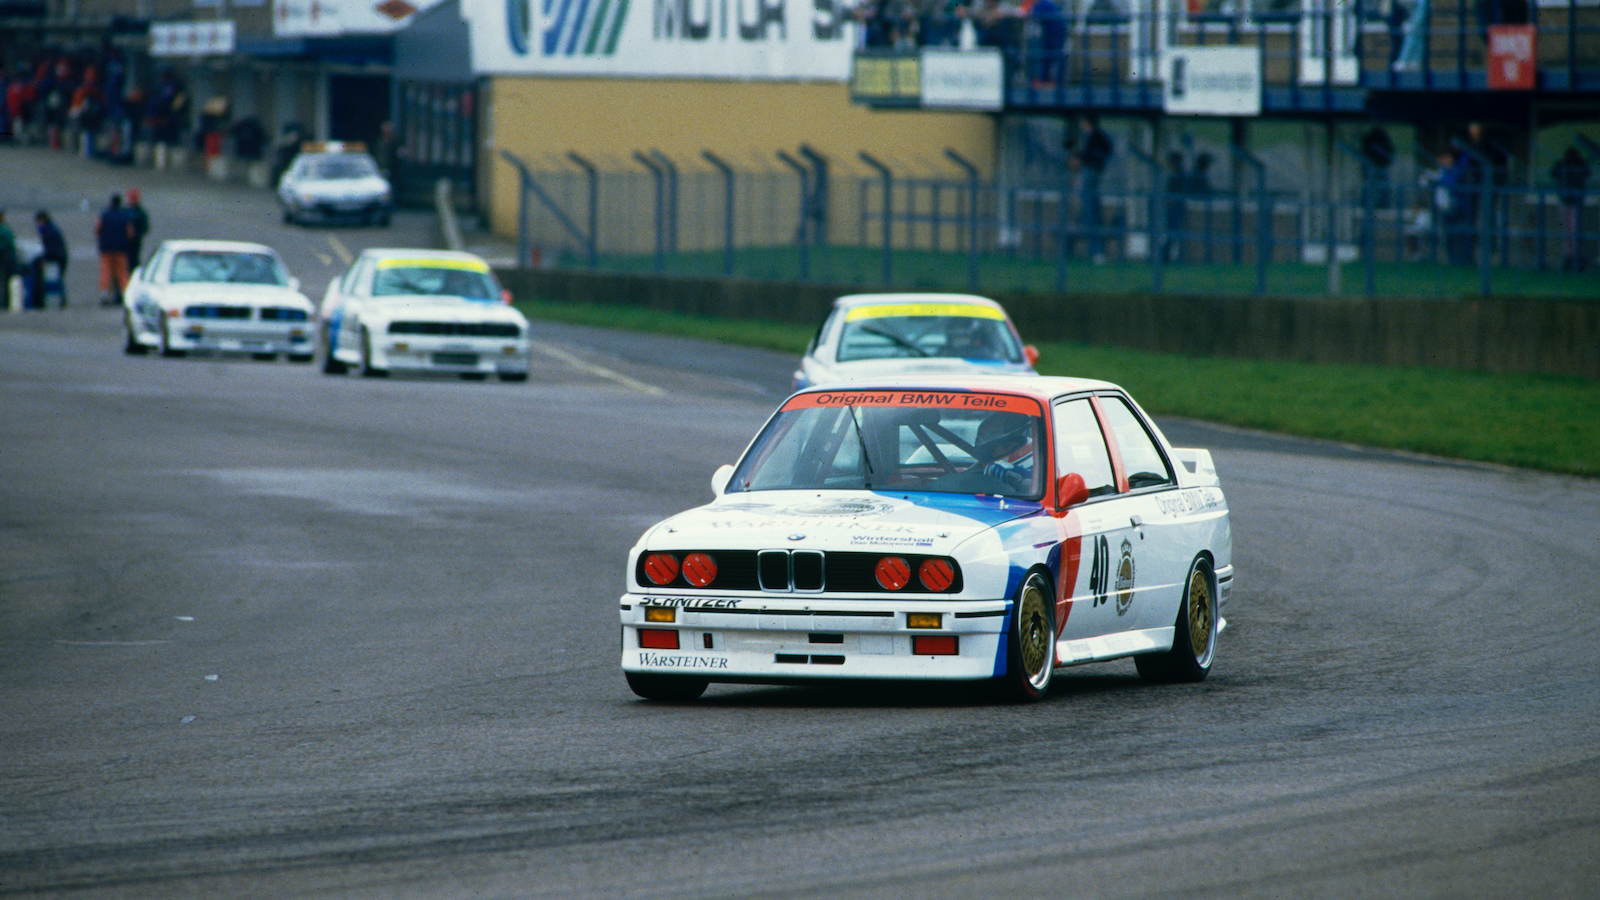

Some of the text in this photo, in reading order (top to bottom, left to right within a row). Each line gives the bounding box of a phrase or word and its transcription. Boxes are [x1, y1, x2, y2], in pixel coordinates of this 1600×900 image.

[816, 394, 1008, 408] Original BMW Teile
[1154, 492, 1186, 518] Original
[1181, 489, 1205, 512] BMW
[1089, 534, 1109, 607] 40
[638, 597, 742, 607] SCHNITZER
[638, 652, 729, 669] WARSTEINER
